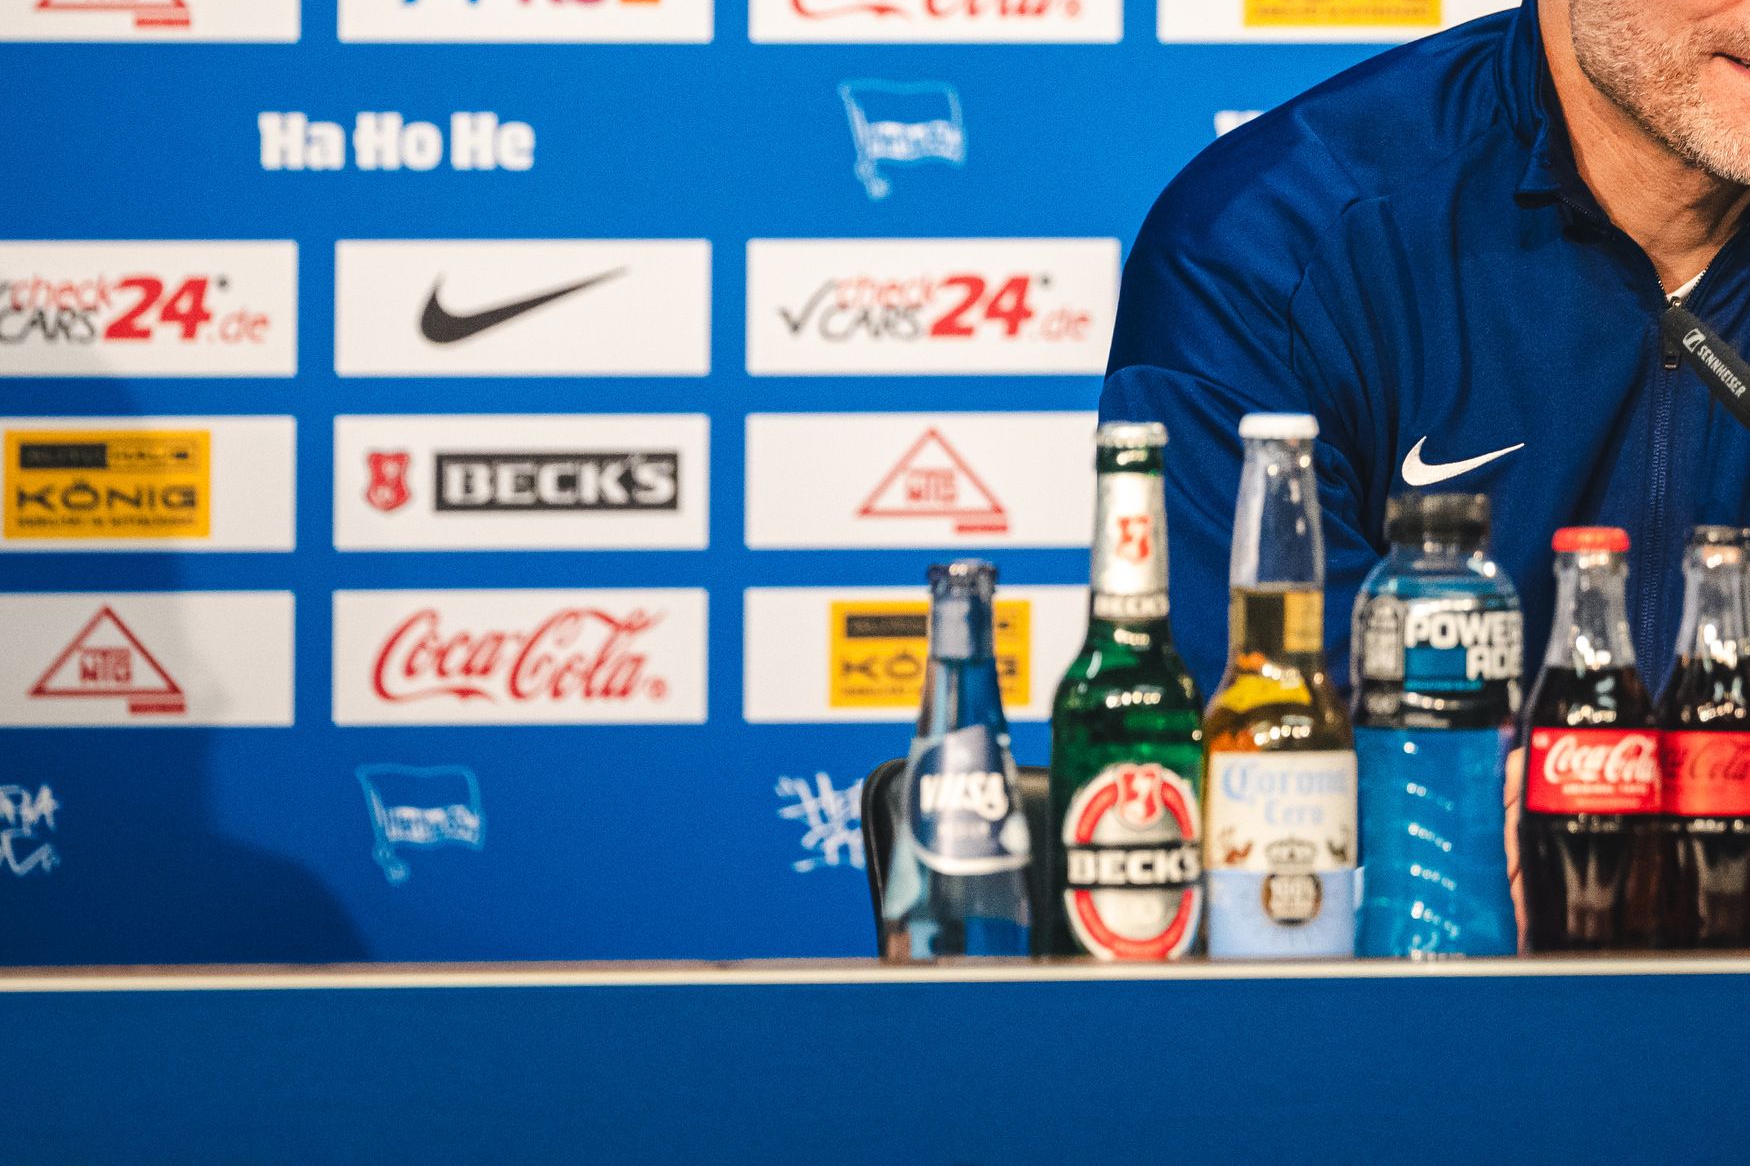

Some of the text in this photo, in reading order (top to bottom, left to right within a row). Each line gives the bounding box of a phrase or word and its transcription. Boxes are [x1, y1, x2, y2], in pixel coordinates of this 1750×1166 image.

[258, 111, 536, 171] Ha Ho He
[103, 275, 213, 341] 24
[929, 275, 1035, 338] 24
[1696, 344, 1747, 399] SENNHEISER
